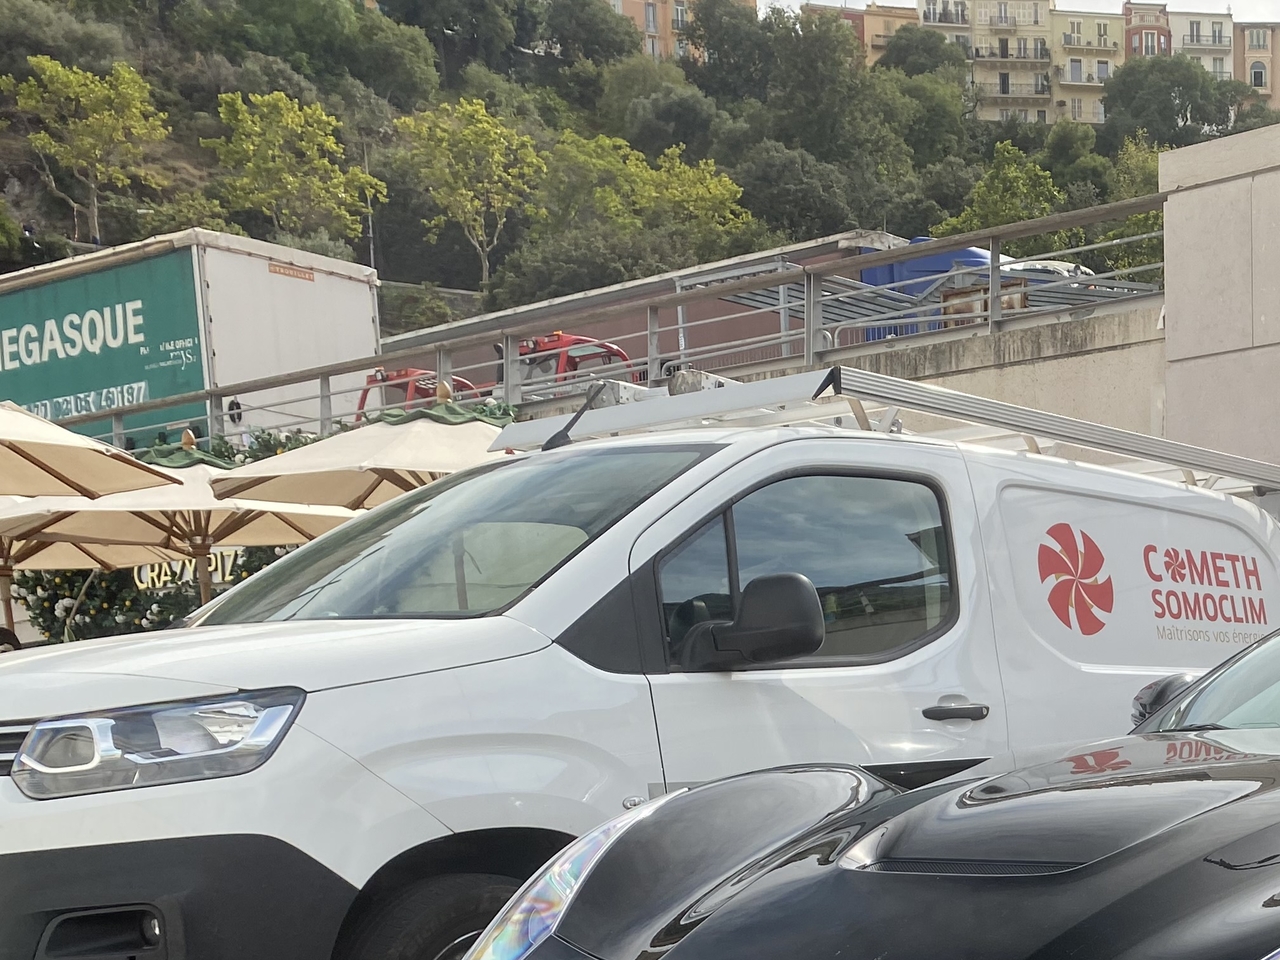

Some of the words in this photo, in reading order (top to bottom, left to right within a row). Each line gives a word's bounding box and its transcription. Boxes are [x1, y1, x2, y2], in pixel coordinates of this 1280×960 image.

[0, 299, 145, 373] EGASQUE
[1150, 588, 1268, 626] SOMOCLIM
[1156, 625, 1211, 642] Maîtrisons
[1212, 630, 1231, 643] vos
